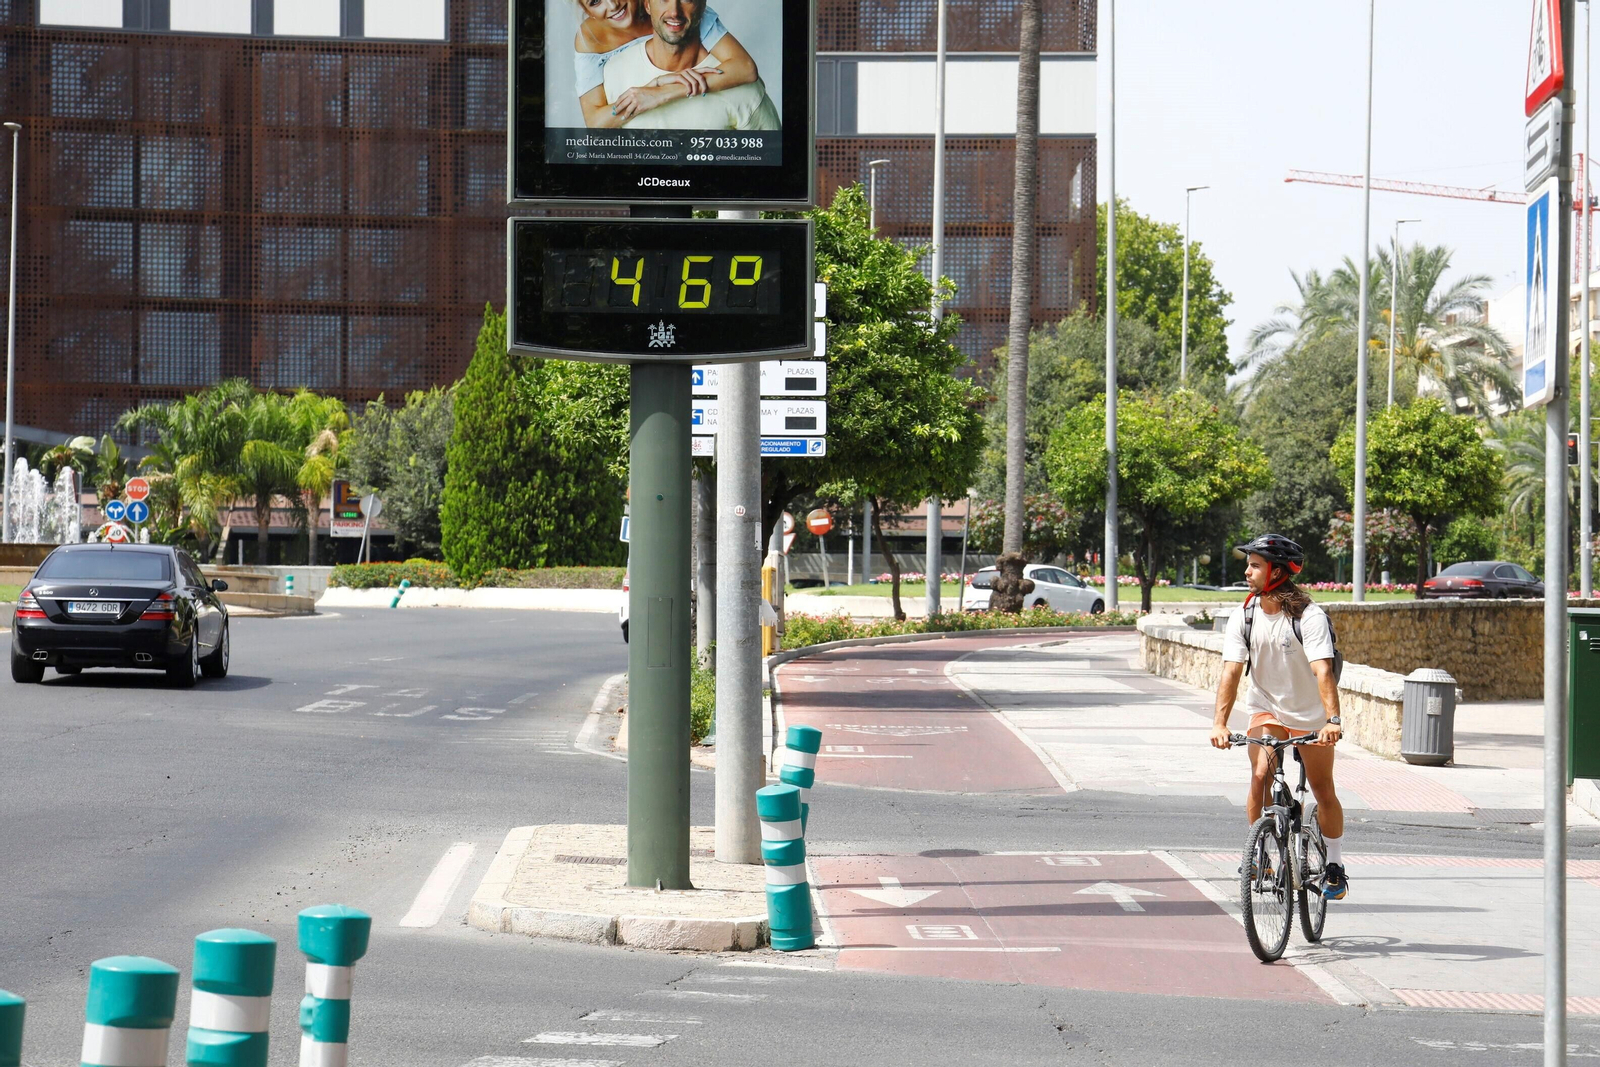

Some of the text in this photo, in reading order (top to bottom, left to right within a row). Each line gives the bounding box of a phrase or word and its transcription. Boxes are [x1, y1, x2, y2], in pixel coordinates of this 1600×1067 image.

[566, 135, 763, 149] medicanclinics.com 957 033 988
[576, 152, 588, 160] José
[637, 177, 691, 187] JCDecaux
[111, 529, 121, 537] 20
[75, 603, 118, 612] 9472 GDR
[293, 699, 507, 720] BUS
